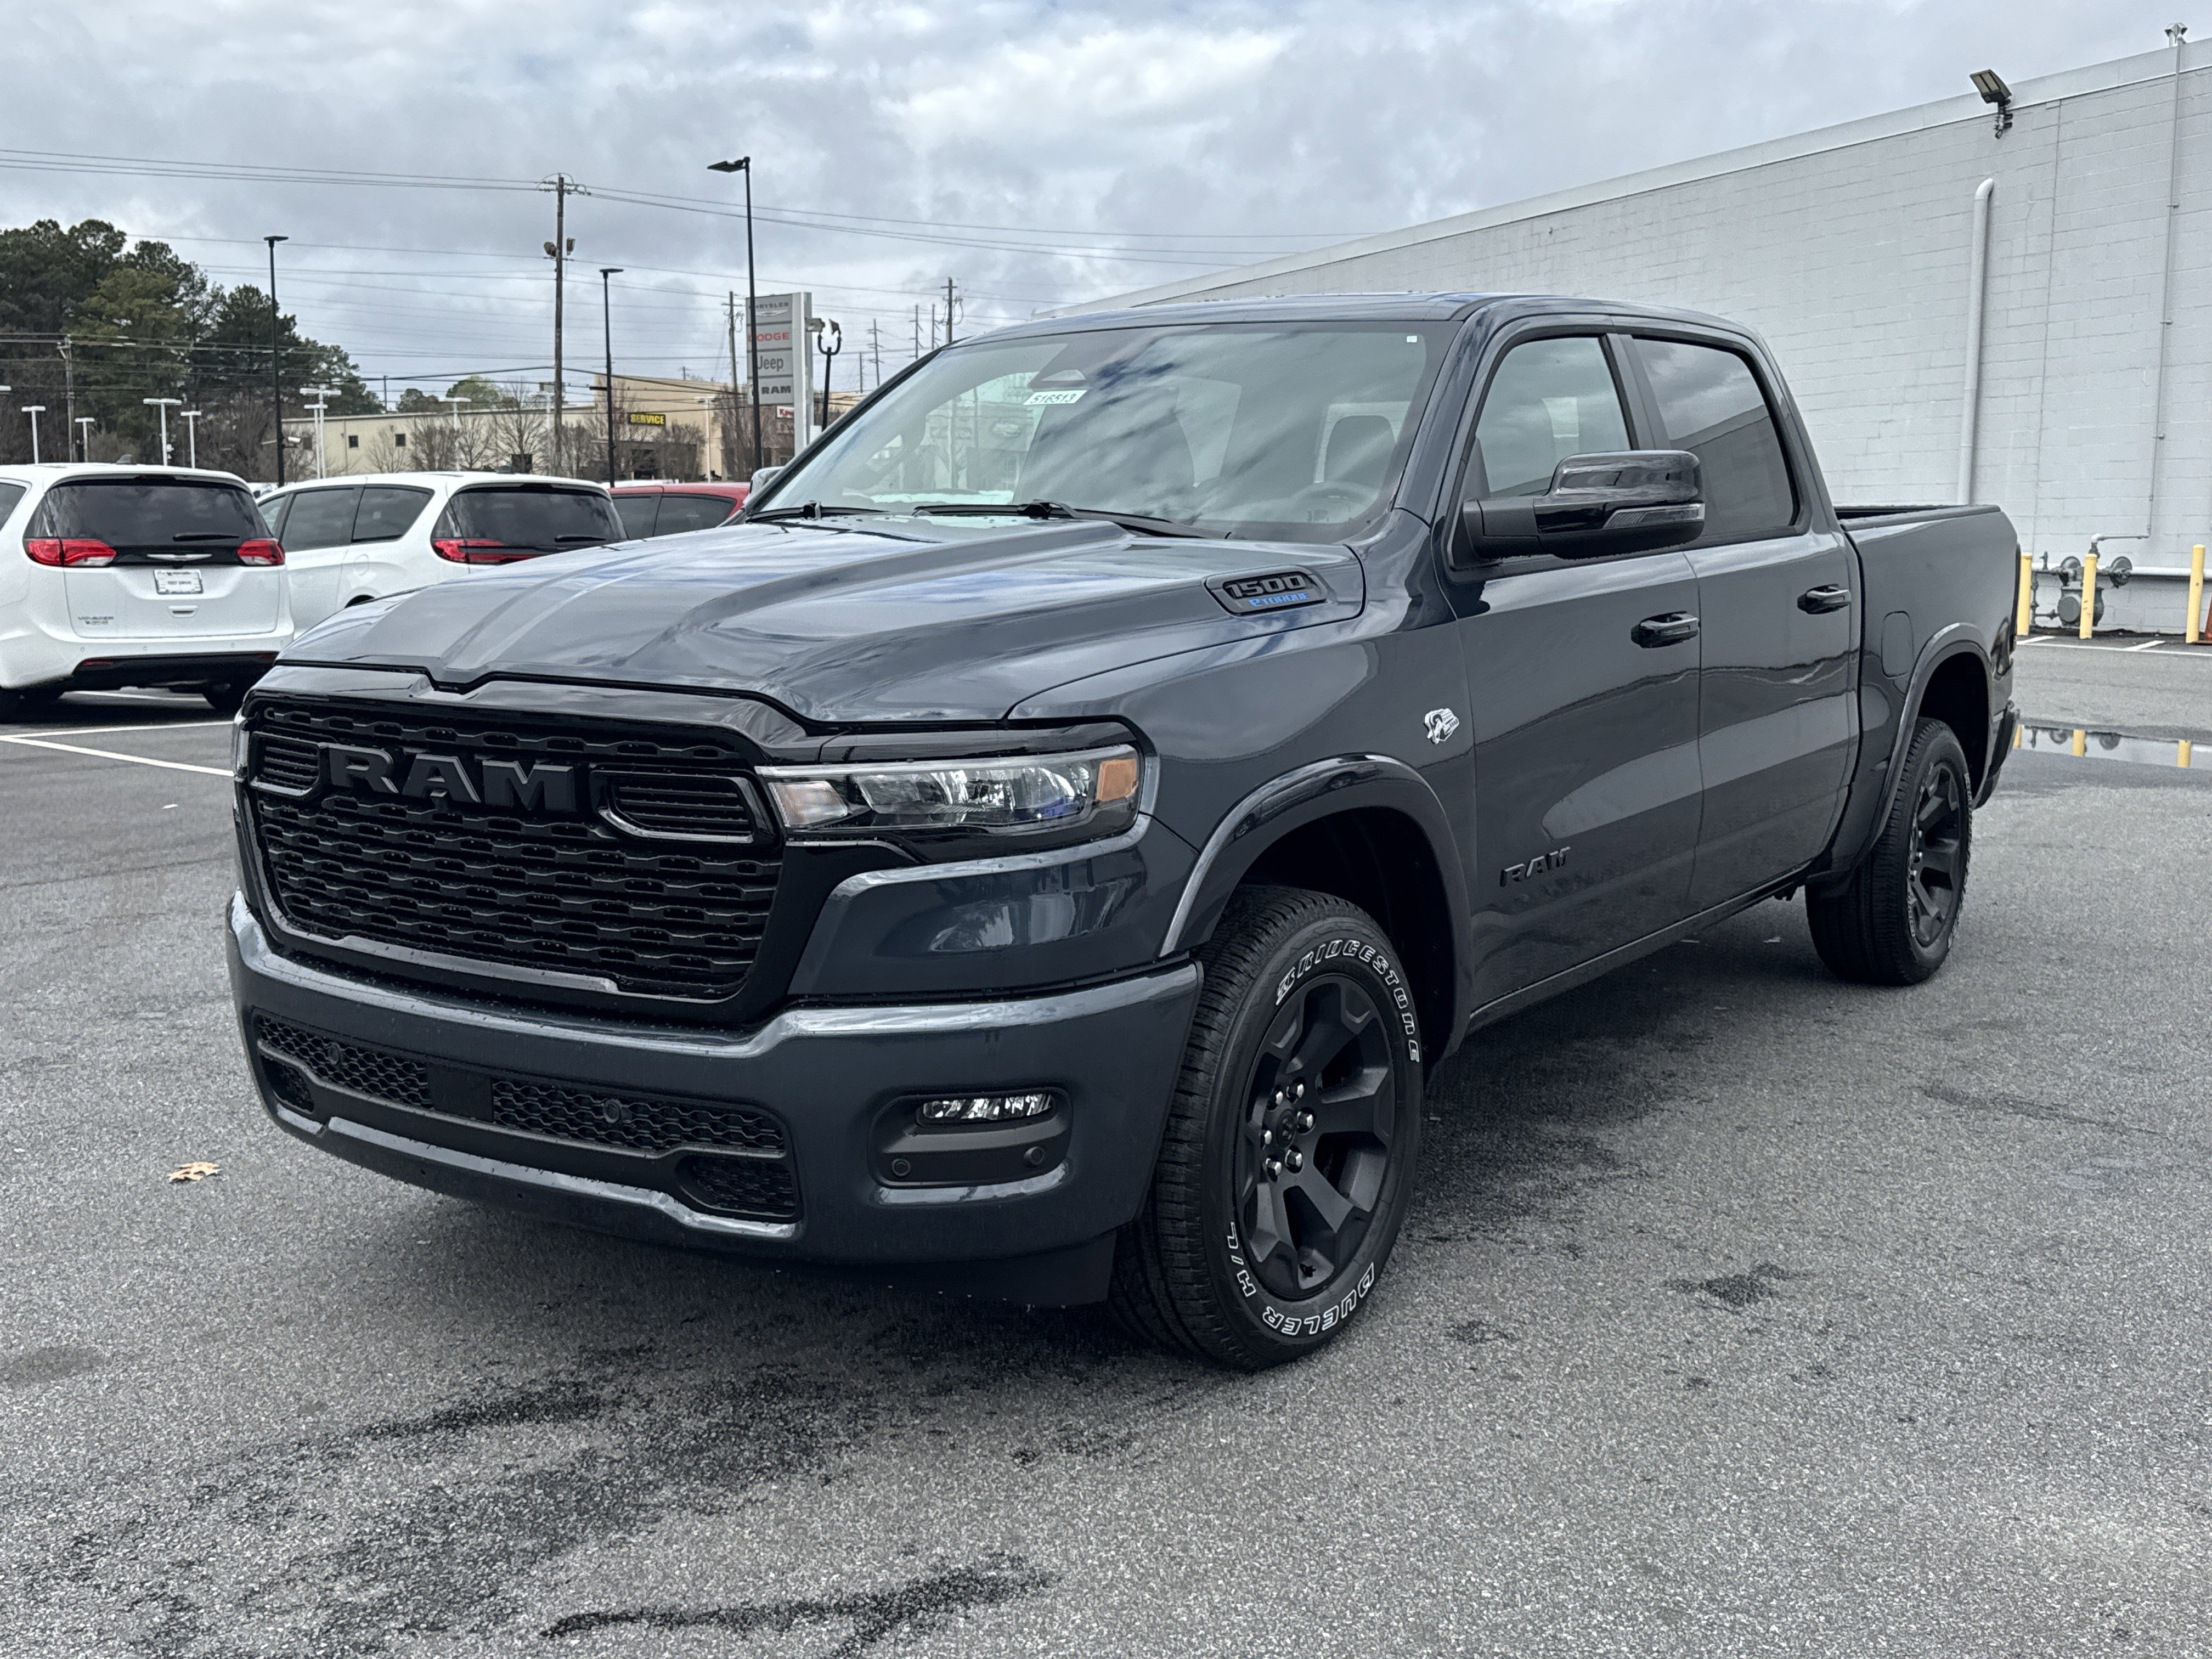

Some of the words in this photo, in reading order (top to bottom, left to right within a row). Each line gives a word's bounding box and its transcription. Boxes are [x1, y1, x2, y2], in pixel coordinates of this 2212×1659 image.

[757, 356, 784, 371] Jeep
[761, 386, 791, 394] RAM
[630, 414, 664, 424] SERVICE
[1226, 575, 1306, 597] 1500
[329, 743, 577, 811] RAM
[1499, 847, 1571, 888] RAM
[1276, 939, 1420, 1063] BRIDGESTONE
[1262, 1262, 1375, 1336] DUELER
